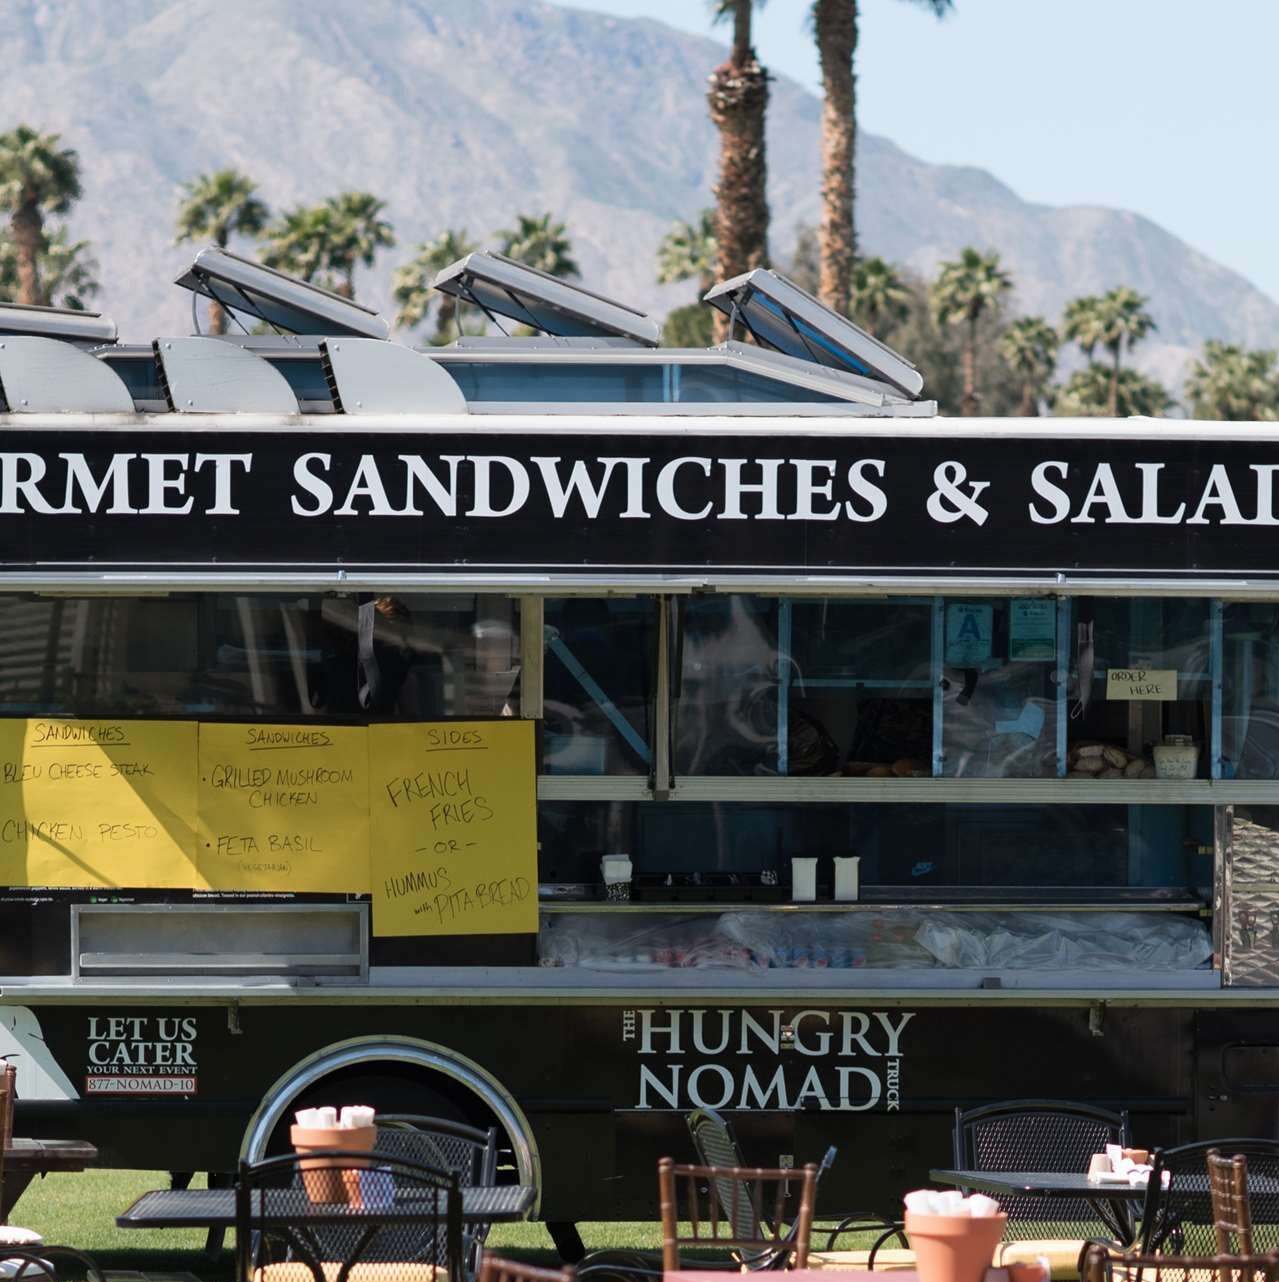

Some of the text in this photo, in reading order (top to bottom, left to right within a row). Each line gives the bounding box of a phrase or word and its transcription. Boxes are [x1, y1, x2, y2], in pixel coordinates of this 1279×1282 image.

[291, 452, 886, 521] SANDWICHES
[926, 461, 990, 526] &
[1111, 671, 1147, 682] ORDER
[1129, 685, 1163, 695] HERE
[33, 723, 125, 742] SANDWICHES
[246, 728, 330, 745] SANDWICHES
[428, 729, 482, 745] SIDES
[3, 762, 155, 784] BLEU CHEESE STEAK
[211, 764, 353, 788] GRILLED MUSHROOM
[248, 790, 318, 808] CHICKEN
[386, 768, 472, 807] FRENCH
[430, 796, 494, 830] FRIES
[2, 819, 158, 843] CHICKEN PESTO
[217, 835, 322, 856] FETA BASIL
[385, 867, 451, 899] HUMMUS
[434, 888, 473, 924] PITA
[475, 876, 530, 909] BREAD
[87, 1017, 198, 1041] LET US
[623, 1010, 635, 1041] THE
[637, 1009, 916, 1057] HUNGRY
[88, 1041, 198, 1065] CATER
[86, 1065, 198, 1075] YOUR NEXT EVENT
[88, 1079, 194, 1091] 877-NOMAD-10
[634, 1063, 882, 1111] NOMAD
[886, 1059, 900, 1112] TRUCK
